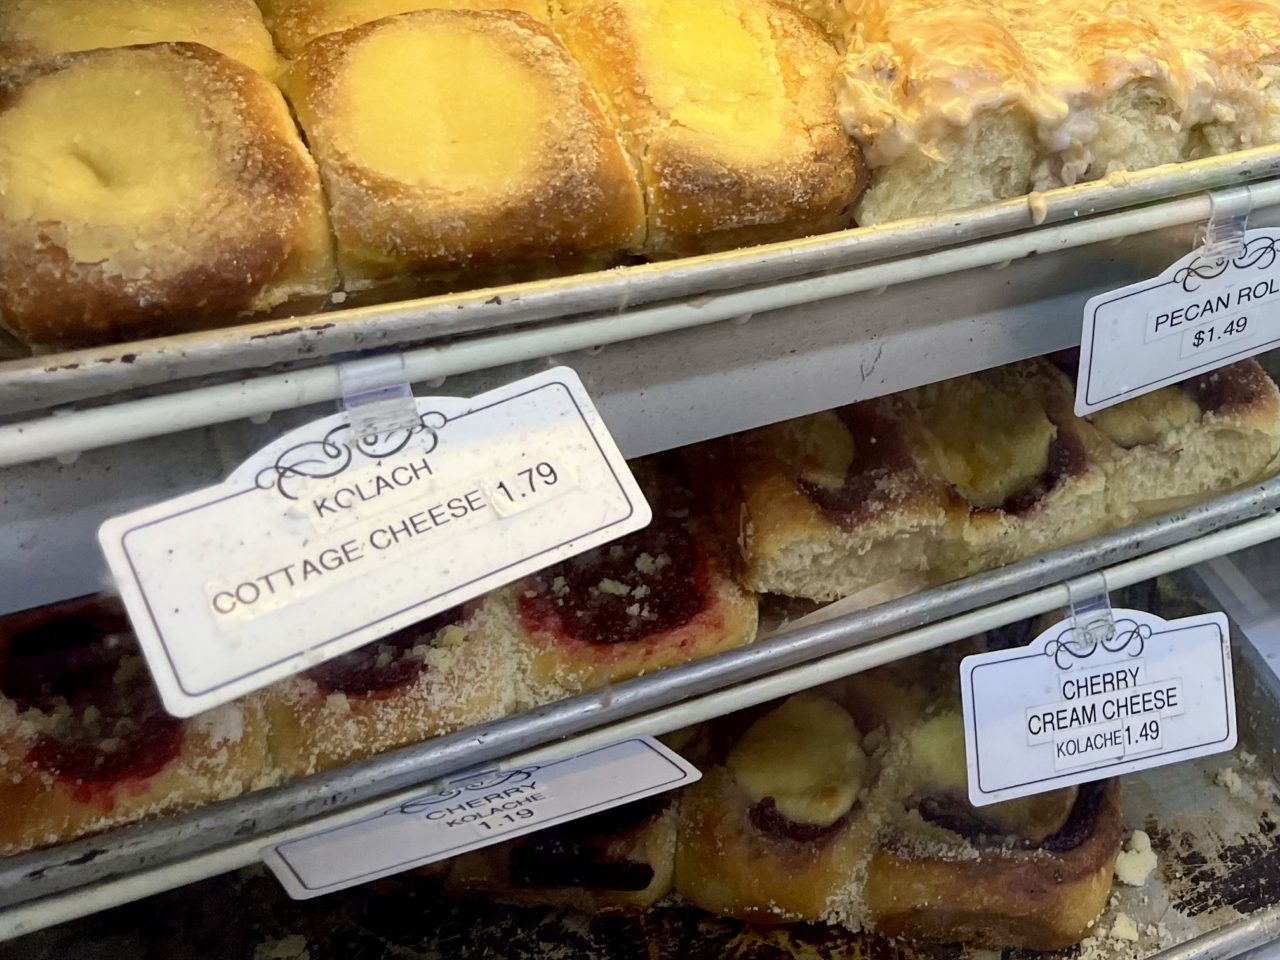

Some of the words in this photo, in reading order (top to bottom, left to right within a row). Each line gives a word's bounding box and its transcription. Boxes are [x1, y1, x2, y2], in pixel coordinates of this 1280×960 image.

[1154, 293, 1230, 332] PECAN
[1192, 316, 1248, 348] $1.49
[313, 458, 433, 518] KOLACH
[212, 538, 365, 615] COTTAGE
[369, 489, 487, 551] CHEESE
[496, 461, 560, 504] 1.79
[1062, 667, 1139, 700] CHERRY
[1028, 704, 1097, 736] CREAM
[1102, 687, 1178, 720] CHEESE
[1056, 729, 1122, 758] KOLACHE
[1124, 720, 1160, 745] 1.49
[426, 781, 536, 820] CHERRY
[446, 792, 546, 827] KOLACHE
